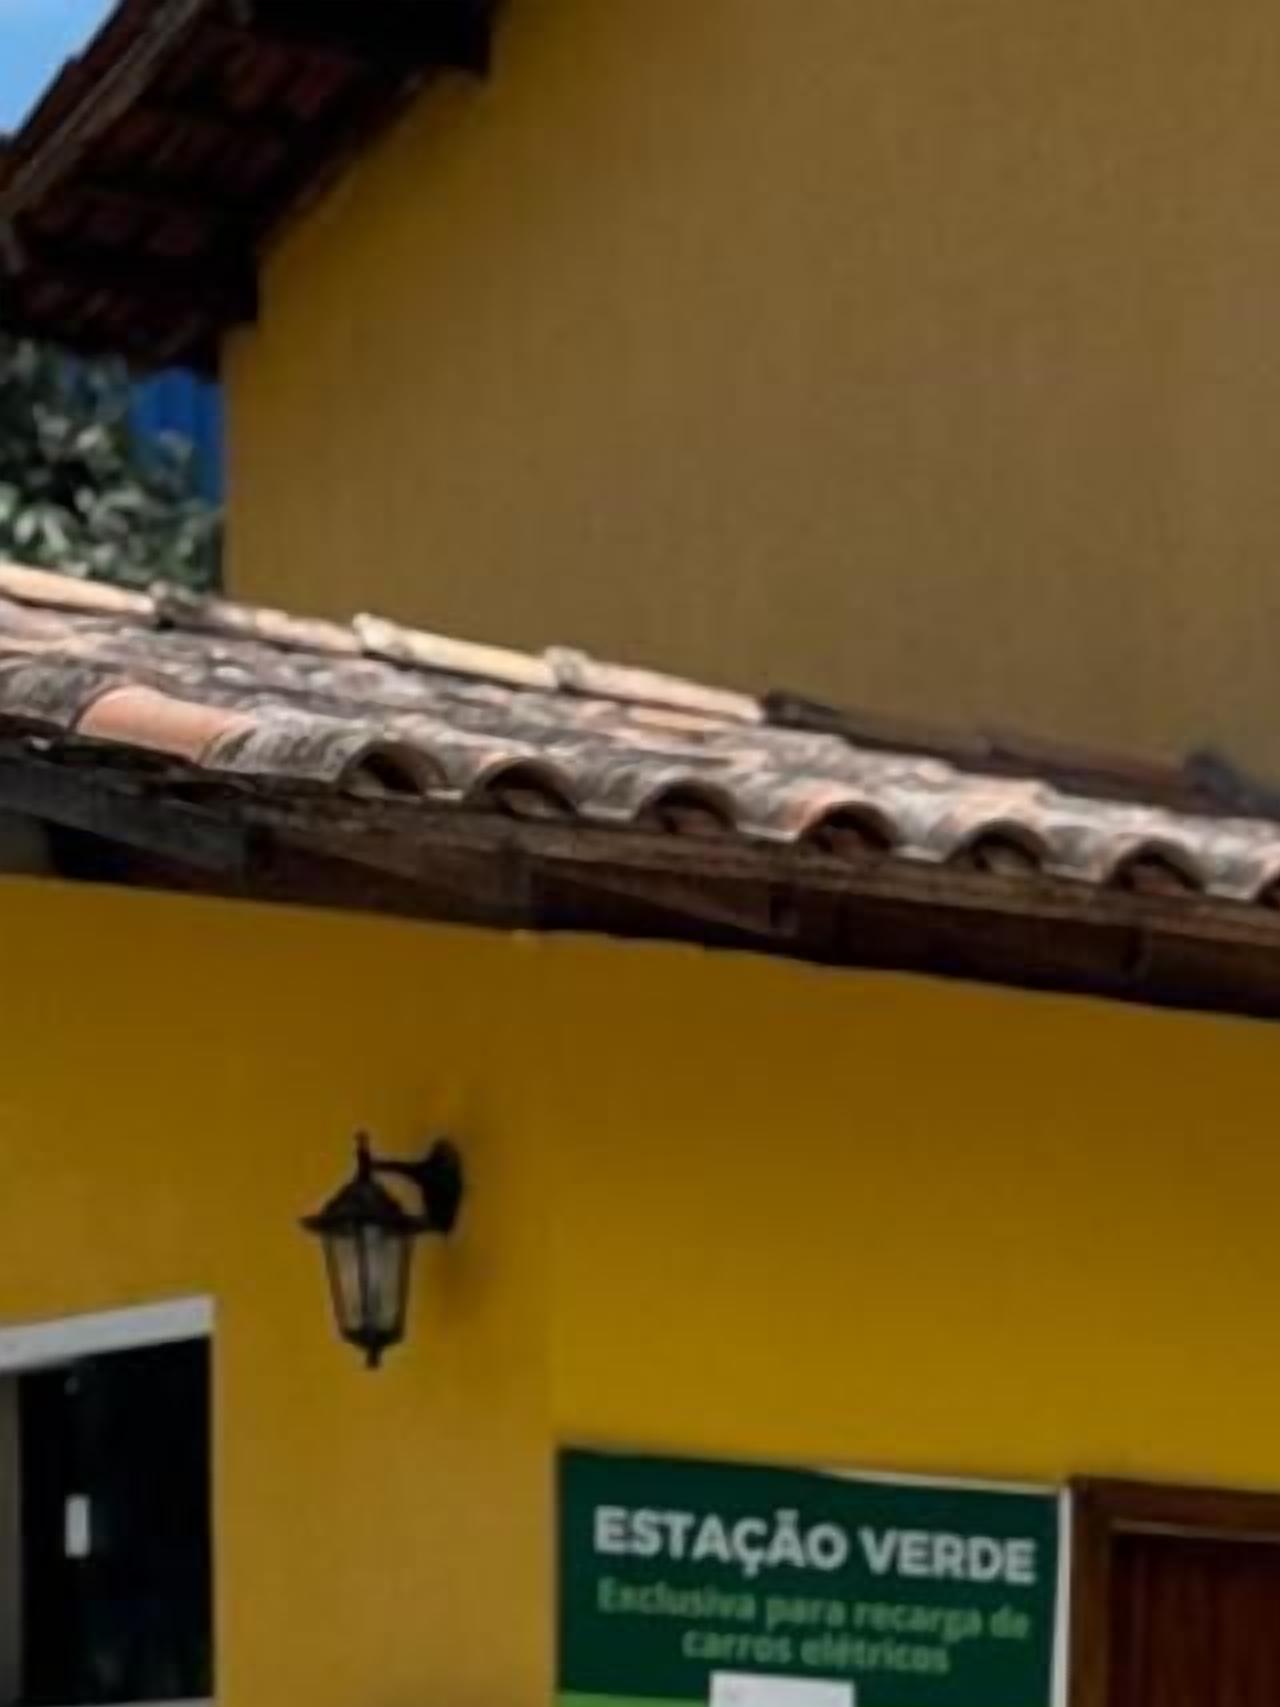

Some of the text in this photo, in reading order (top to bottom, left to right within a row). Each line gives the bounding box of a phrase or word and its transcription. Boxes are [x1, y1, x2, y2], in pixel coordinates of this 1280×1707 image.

[594, 1505, 1036, 1584] ESTAÇÃO VERDE
[598, 1576, 1031, 1643] Exclusiva para recarga de
[681, 1630, 949, 1674] carros elétricos
